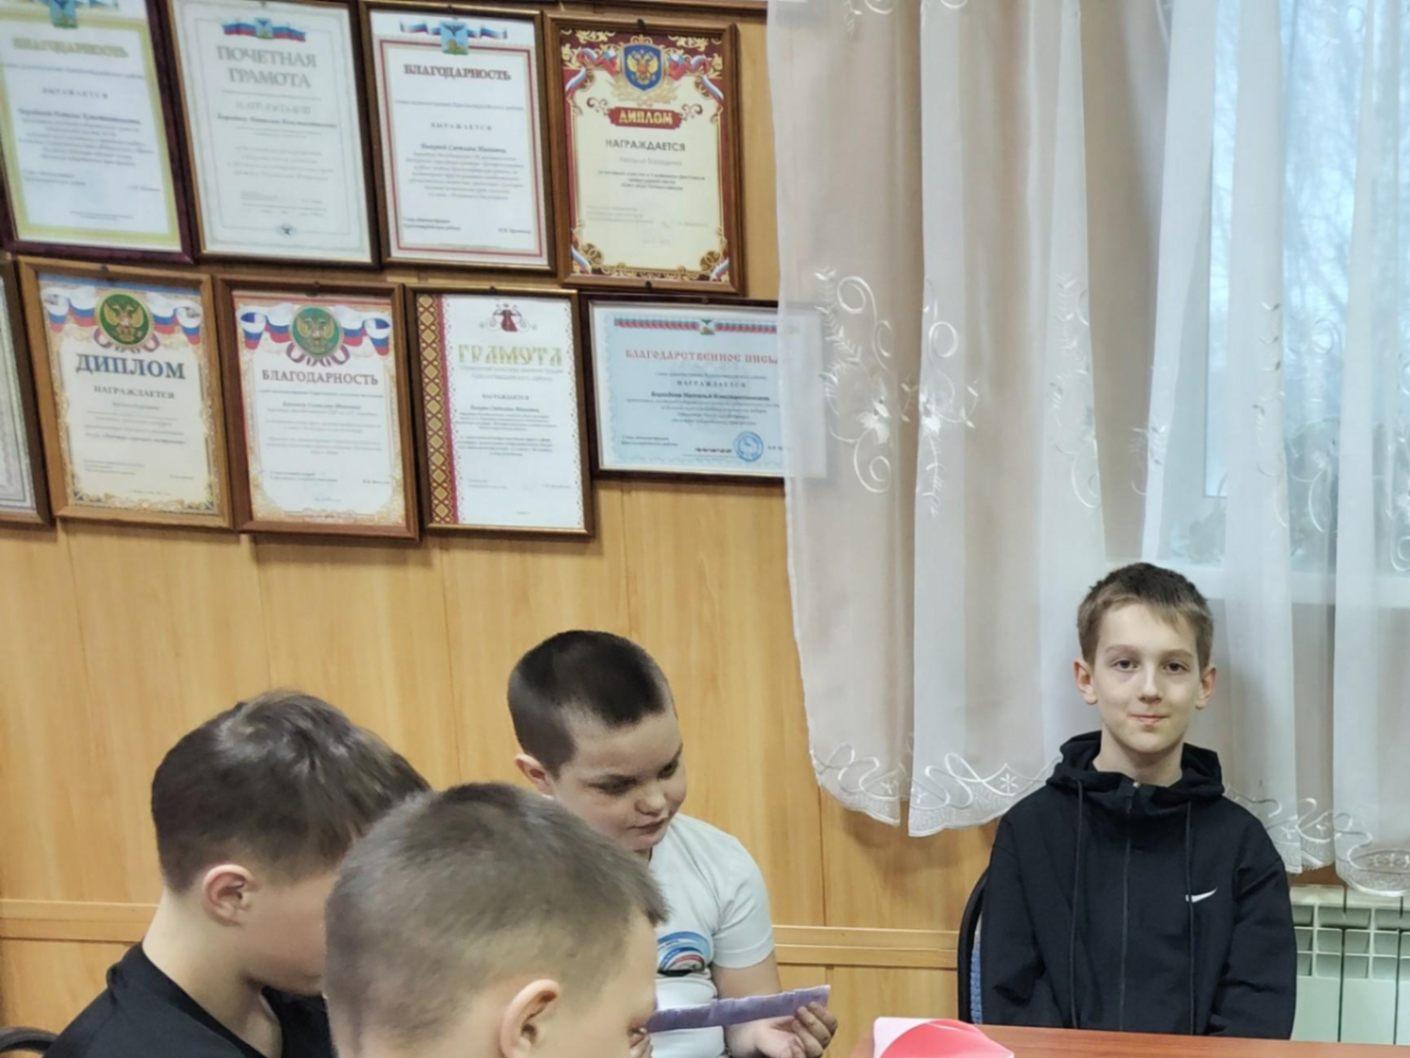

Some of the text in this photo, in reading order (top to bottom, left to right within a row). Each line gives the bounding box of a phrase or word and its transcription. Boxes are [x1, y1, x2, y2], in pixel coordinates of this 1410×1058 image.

[216, 45, 318, 69] ПОЧЕТНАЯ
[228, 67, 312, 89] ГРАМОТА
[403, 63, 512, 82] БЛАГОДАРНОСТЬ
[618, 109, 675, 126] ДИПЛОМ
[605, 139, 686, 152] НАГРАЖДАЕТСЯ
[75, 353, 186, 380] ДИПЛОМ
[262, 369, 379, 386] БЛАГОДАРНОСТЬ
